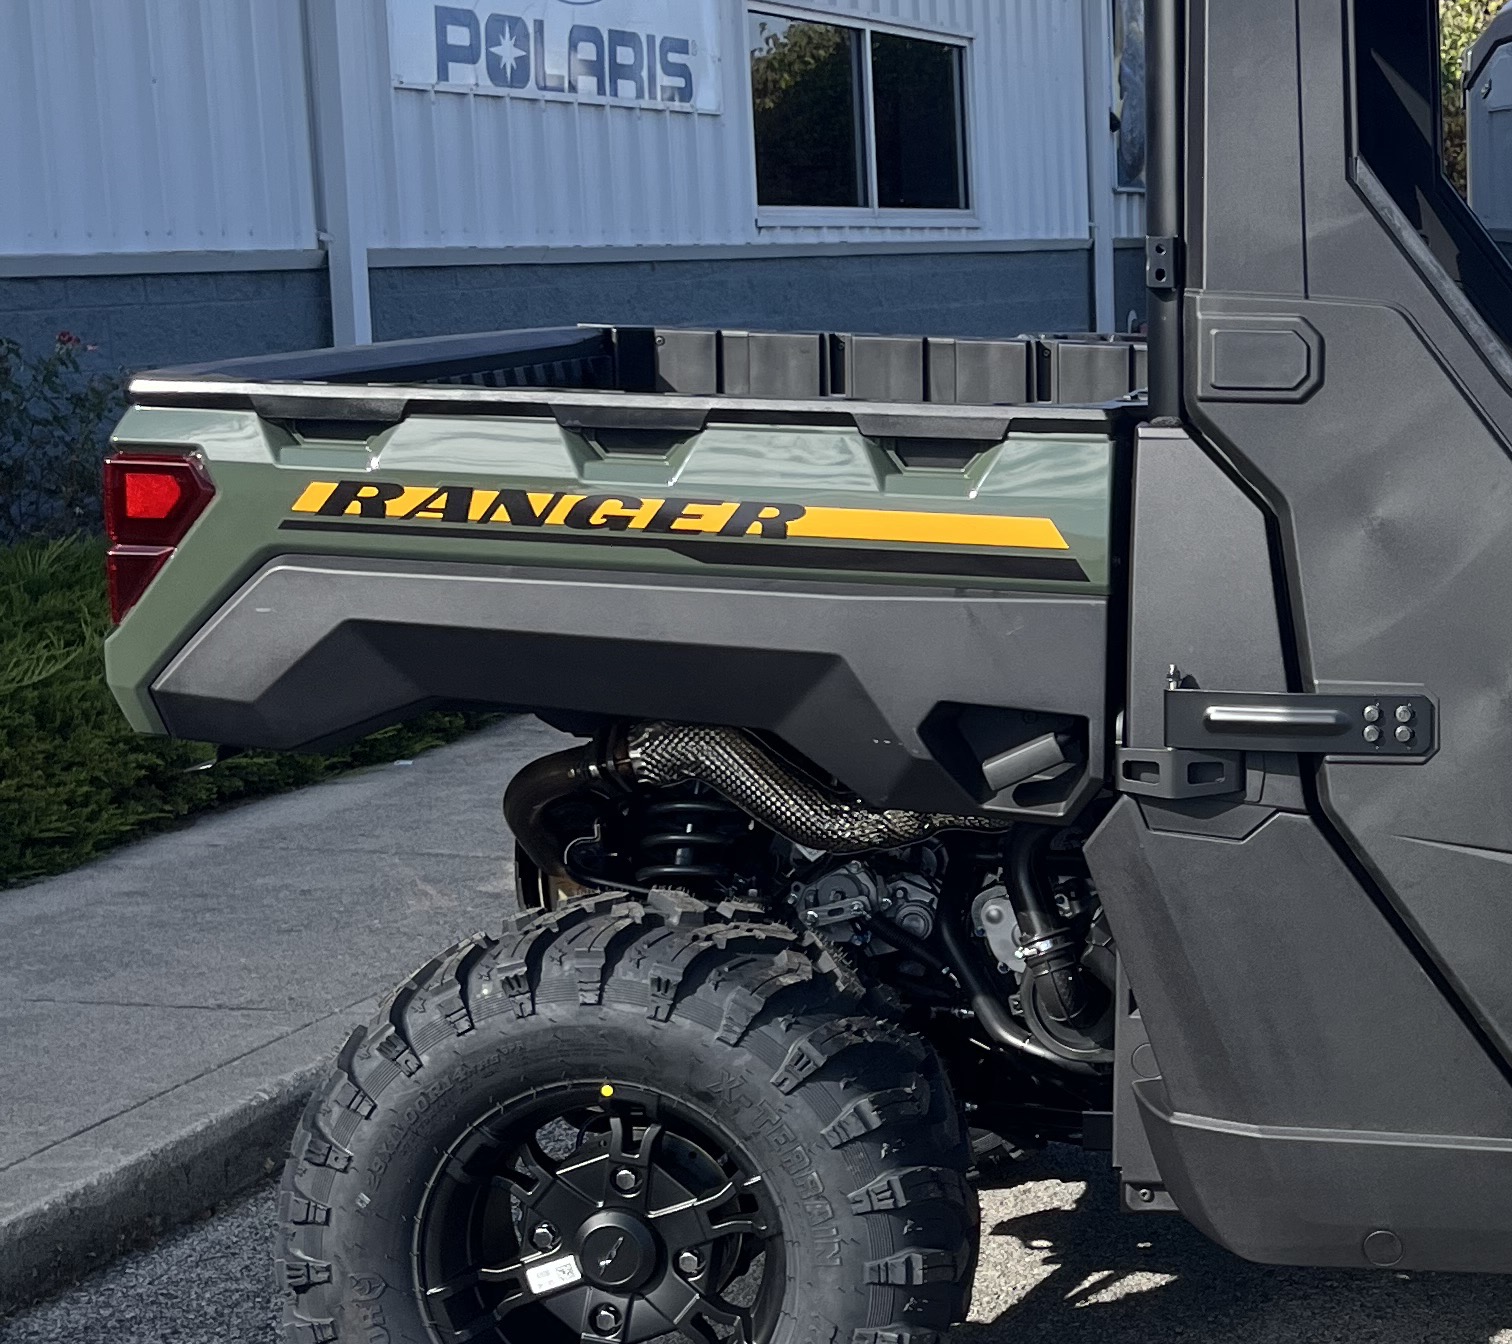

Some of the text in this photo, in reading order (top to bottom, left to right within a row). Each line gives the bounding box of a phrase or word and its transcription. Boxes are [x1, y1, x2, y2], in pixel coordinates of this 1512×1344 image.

[434, 4, 694, 104] POLARIS
[315, 479, 807, 540] RANGER
[706, 1067, 843, 1267] X-TERRAIN
